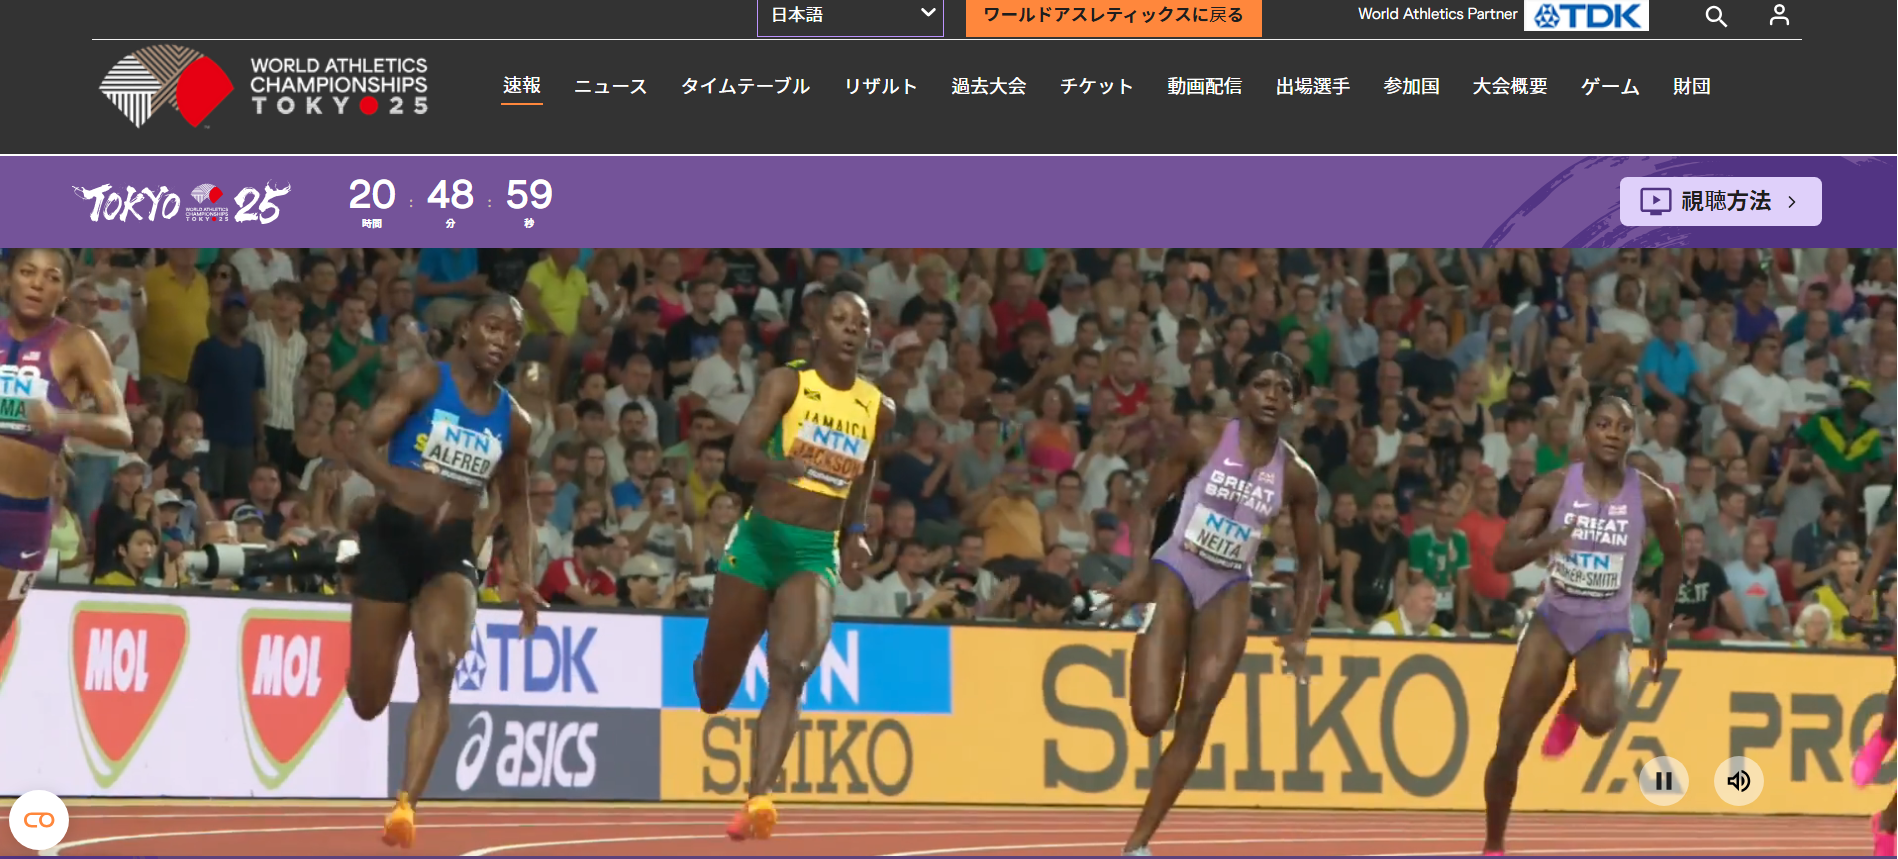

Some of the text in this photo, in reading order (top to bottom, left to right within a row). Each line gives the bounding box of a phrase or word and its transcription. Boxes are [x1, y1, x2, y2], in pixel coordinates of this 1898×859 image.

[772, 5, 824, 24] 日本語
[984, 5, 1244, 25] ワールドアスレティックスに戻る
[1357, 6, 1519, 21] World Athletics Partner
[1559, 3, 1642, 28] TDK
[250, 57, 428, 73] WORLD ATHLETICS
[250, 76, 428, 92] CHAMPIONSHIPS
[502, 75, 542, 95] 速報
[574, 78, 648, 95] ニュース
[681, 76, 811, 95] タイムテーブル
[846, 76, 917, 95] リザルト
[950, 76, 1028, 95] 過去大会
[1059, 76, 1134, 95] チケット
[1167, 76, 1244, 95] 動画配信
[1276, 76, 1351, 95] 出場選手
[1383, 76, 1440, 95] 参加国
[1472, 76, 1549, 95] 大会概要
[1580, 76, 1640, 95] ゲーム
[1672, 76, 1711, 95] 財団
[389, 96, 429, 115] 25
[72, 183, 181, 222] TOKYO
[233, 179, 291, 225] 25
[349, 178, 396, 210] 20
[426, 178, 475, 210] 48
[506, 178, 553, 210] 59
[1681, 189, 1772, 213] 視聴方法
[361, 218, 383, 229] 時間
[445, 218, 457, 229] 分
[523, 217, 537, 229] 秒
[444, 426, 491, 455] NTN
[812, 426, 860, 456] NTN
[428, 444, 491, 475] ALFRED
[1210, 469, 1275, 503] GREAT
[1204, 482, 1273, 516] BRITAIN
[1206, 513, 1252, 542] NTN
[1563, 512, 1629, 533] GREAT
[1197, 528, 1242, 559] NEITA
[84, 627, 149, 692] MOL
[252, 634, 321, 697] MOL
[486, 623, 599, 694] TDK
